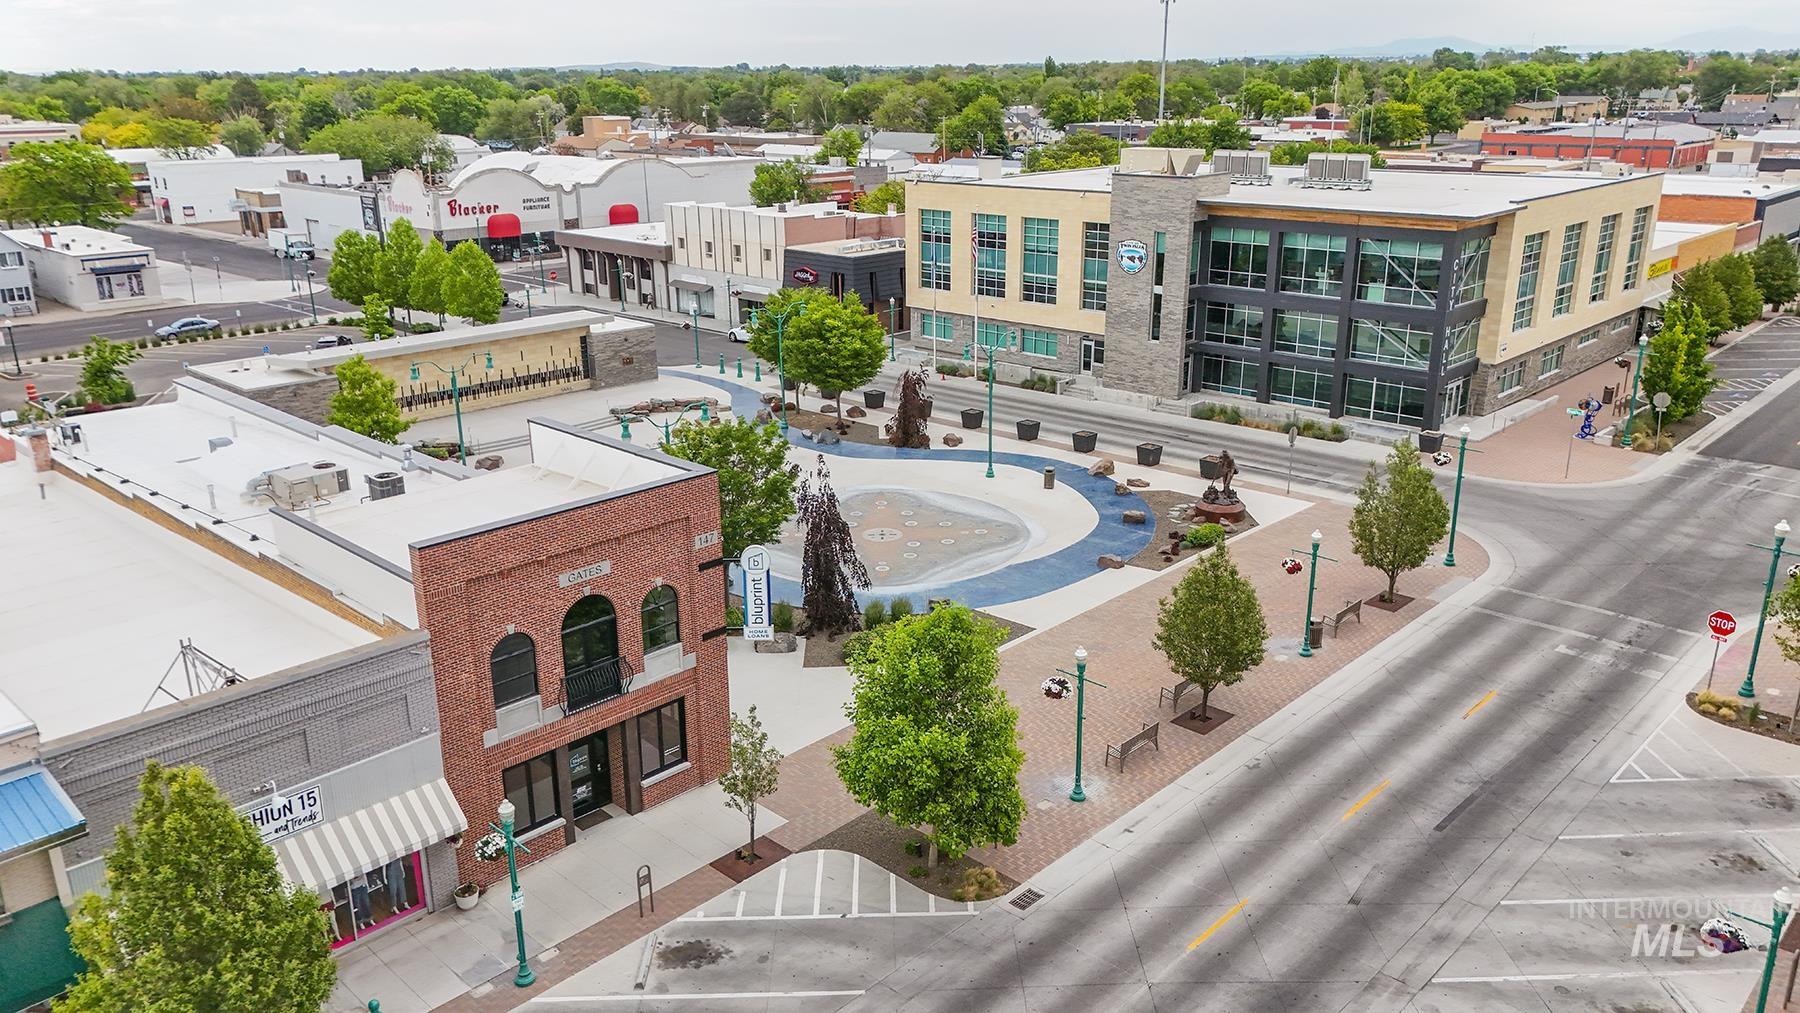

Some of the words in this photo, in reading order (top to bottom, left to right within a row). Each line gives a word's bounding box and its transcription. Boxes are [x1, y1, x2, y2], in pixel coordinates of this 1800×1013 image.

[447, 199, 499, 216] Blacker
[1450, 259, 1459, 311] CITY
[1441, 326, 1451, 376] HALL
[699, 533, 715, 546] 147
[567, 565, 603, 583] GATES
[751, 577, 765, 625] bluprint
[1710, 617, 1735, 630] STOP
[297, 790, 317, 811] 15
[274, 820, 290, 834] and
[287, 810, 320, 831] Trends
